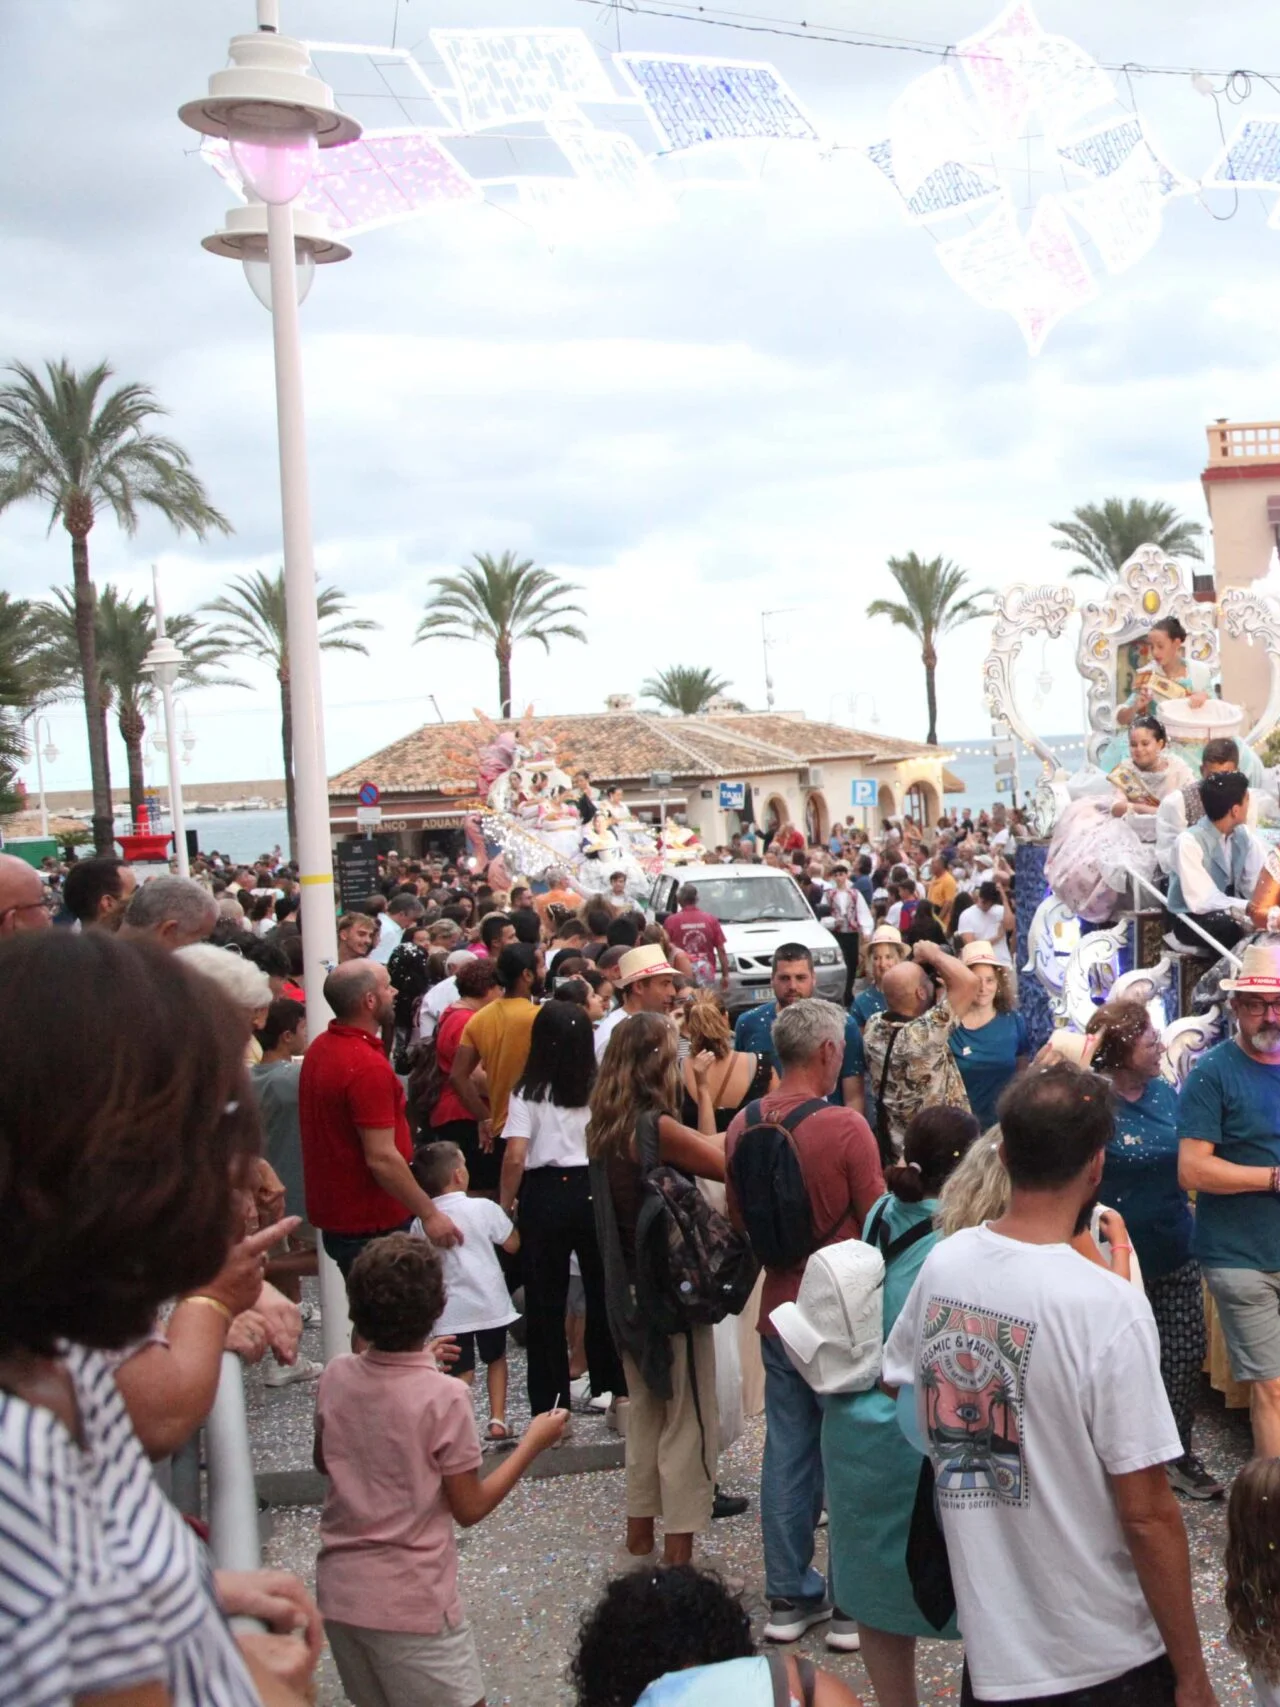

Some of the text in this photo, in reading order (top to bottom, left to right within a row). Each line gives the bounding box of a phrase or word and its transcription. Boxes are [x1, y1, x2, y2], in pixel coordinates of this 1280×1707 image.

[720, 790, 743, 800] TAXI
[856, 782, 872, 804] P
[955, 1335, 963, 1348] &
[967, 1338, 994, 1362] MAGIC
